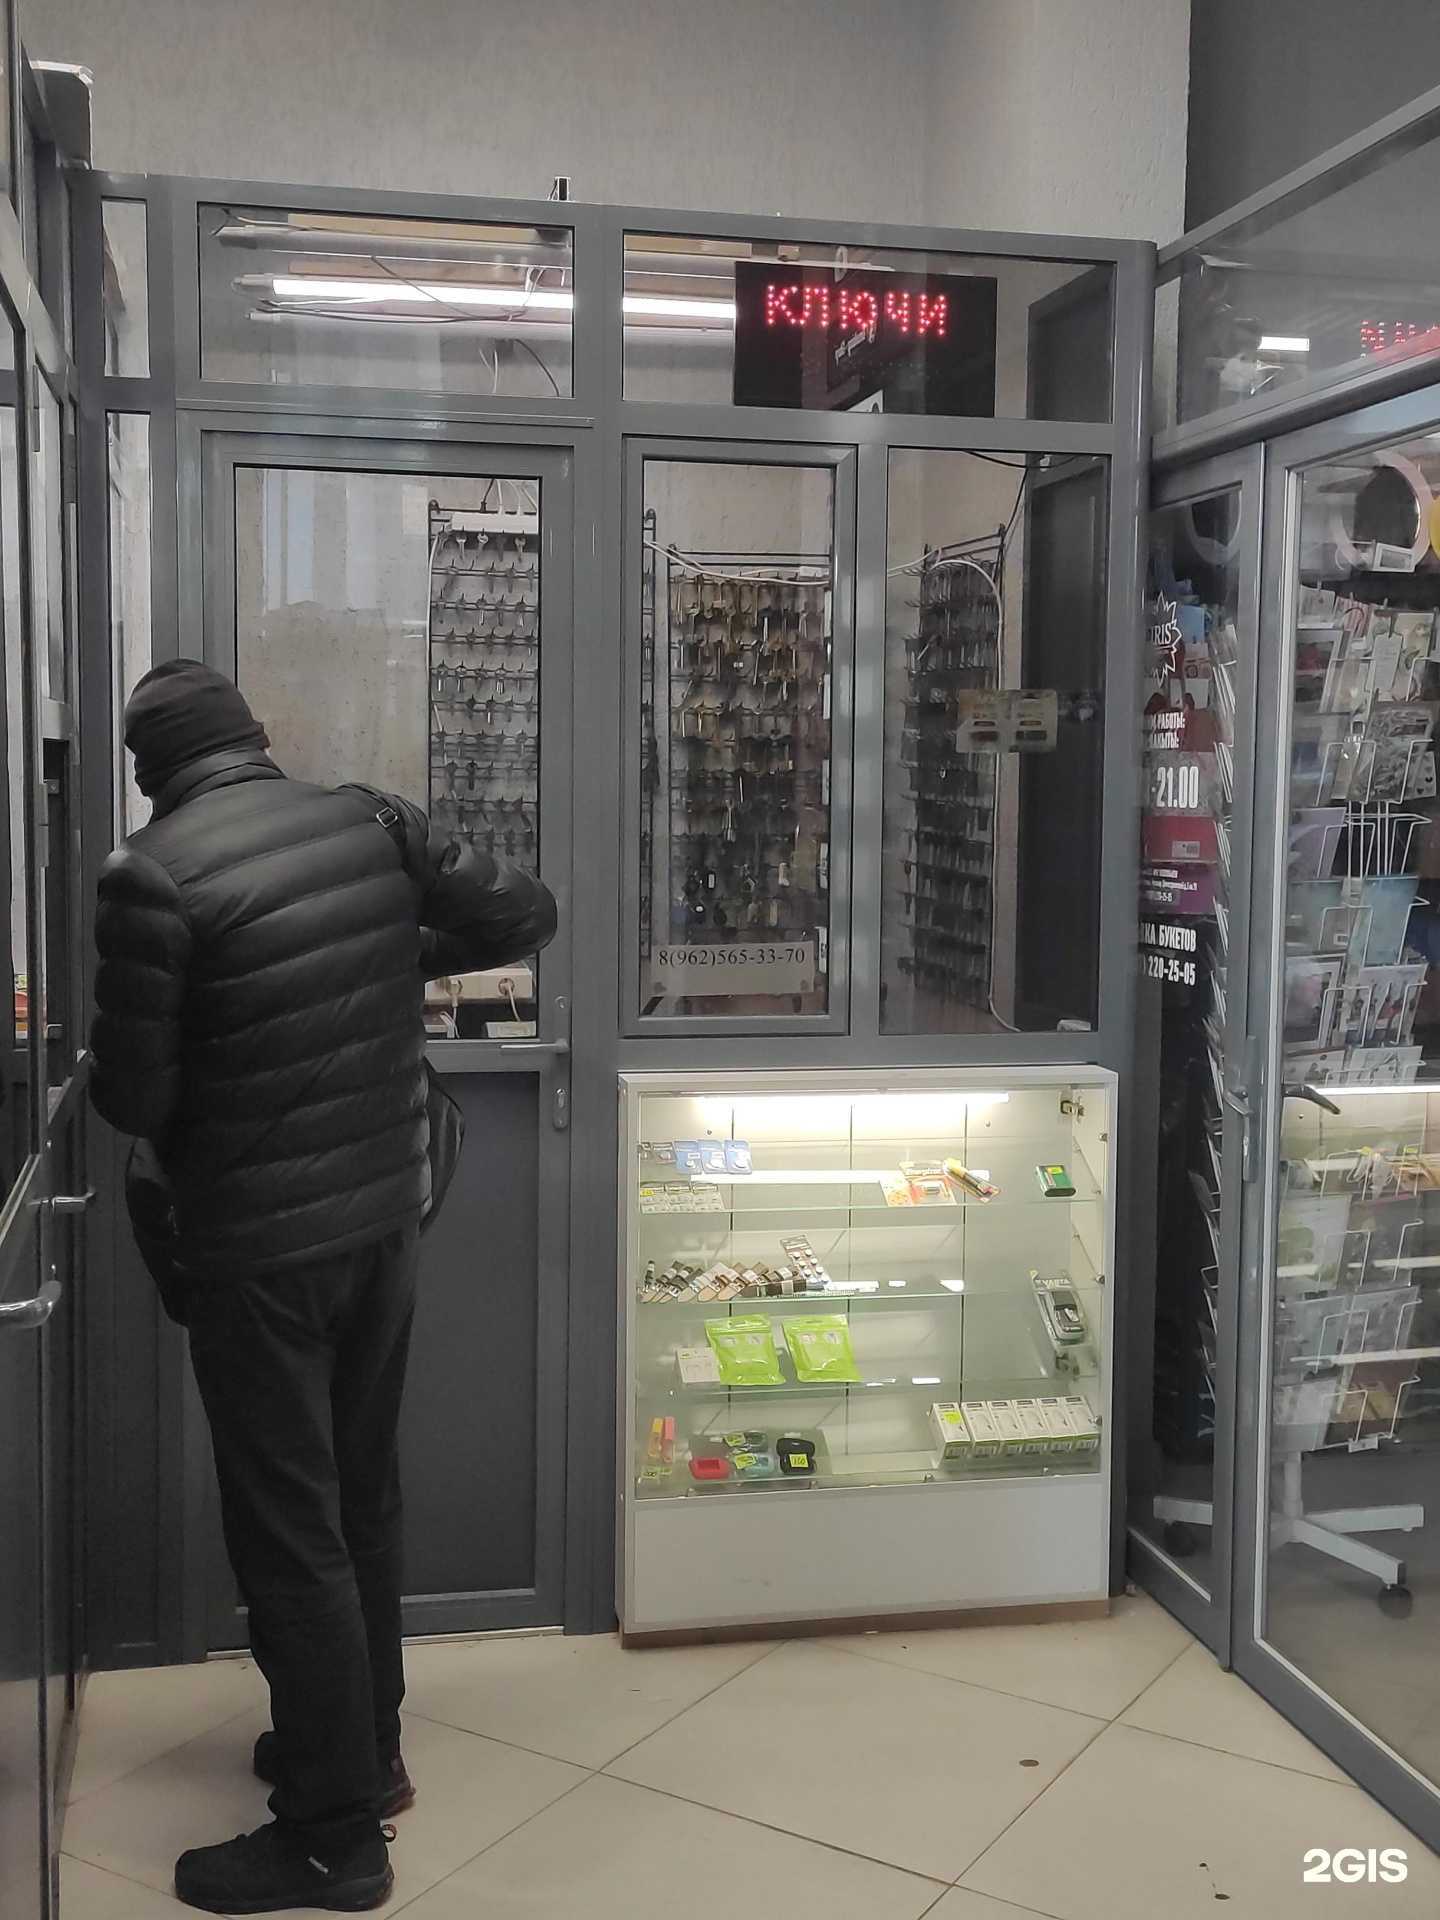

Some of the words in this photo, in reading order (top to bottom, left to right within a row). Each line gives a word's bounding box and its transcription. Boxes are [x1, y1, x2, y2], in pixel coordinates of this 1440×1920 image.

[765, 283, 948, 336] КЛЮЧИ
[1158, 924, 1197, 952] БУКЕТОВ
[658, 948, 806, 968] 8(962)565-33-70
[1148, 955, 1196, 986] 220-25-05
